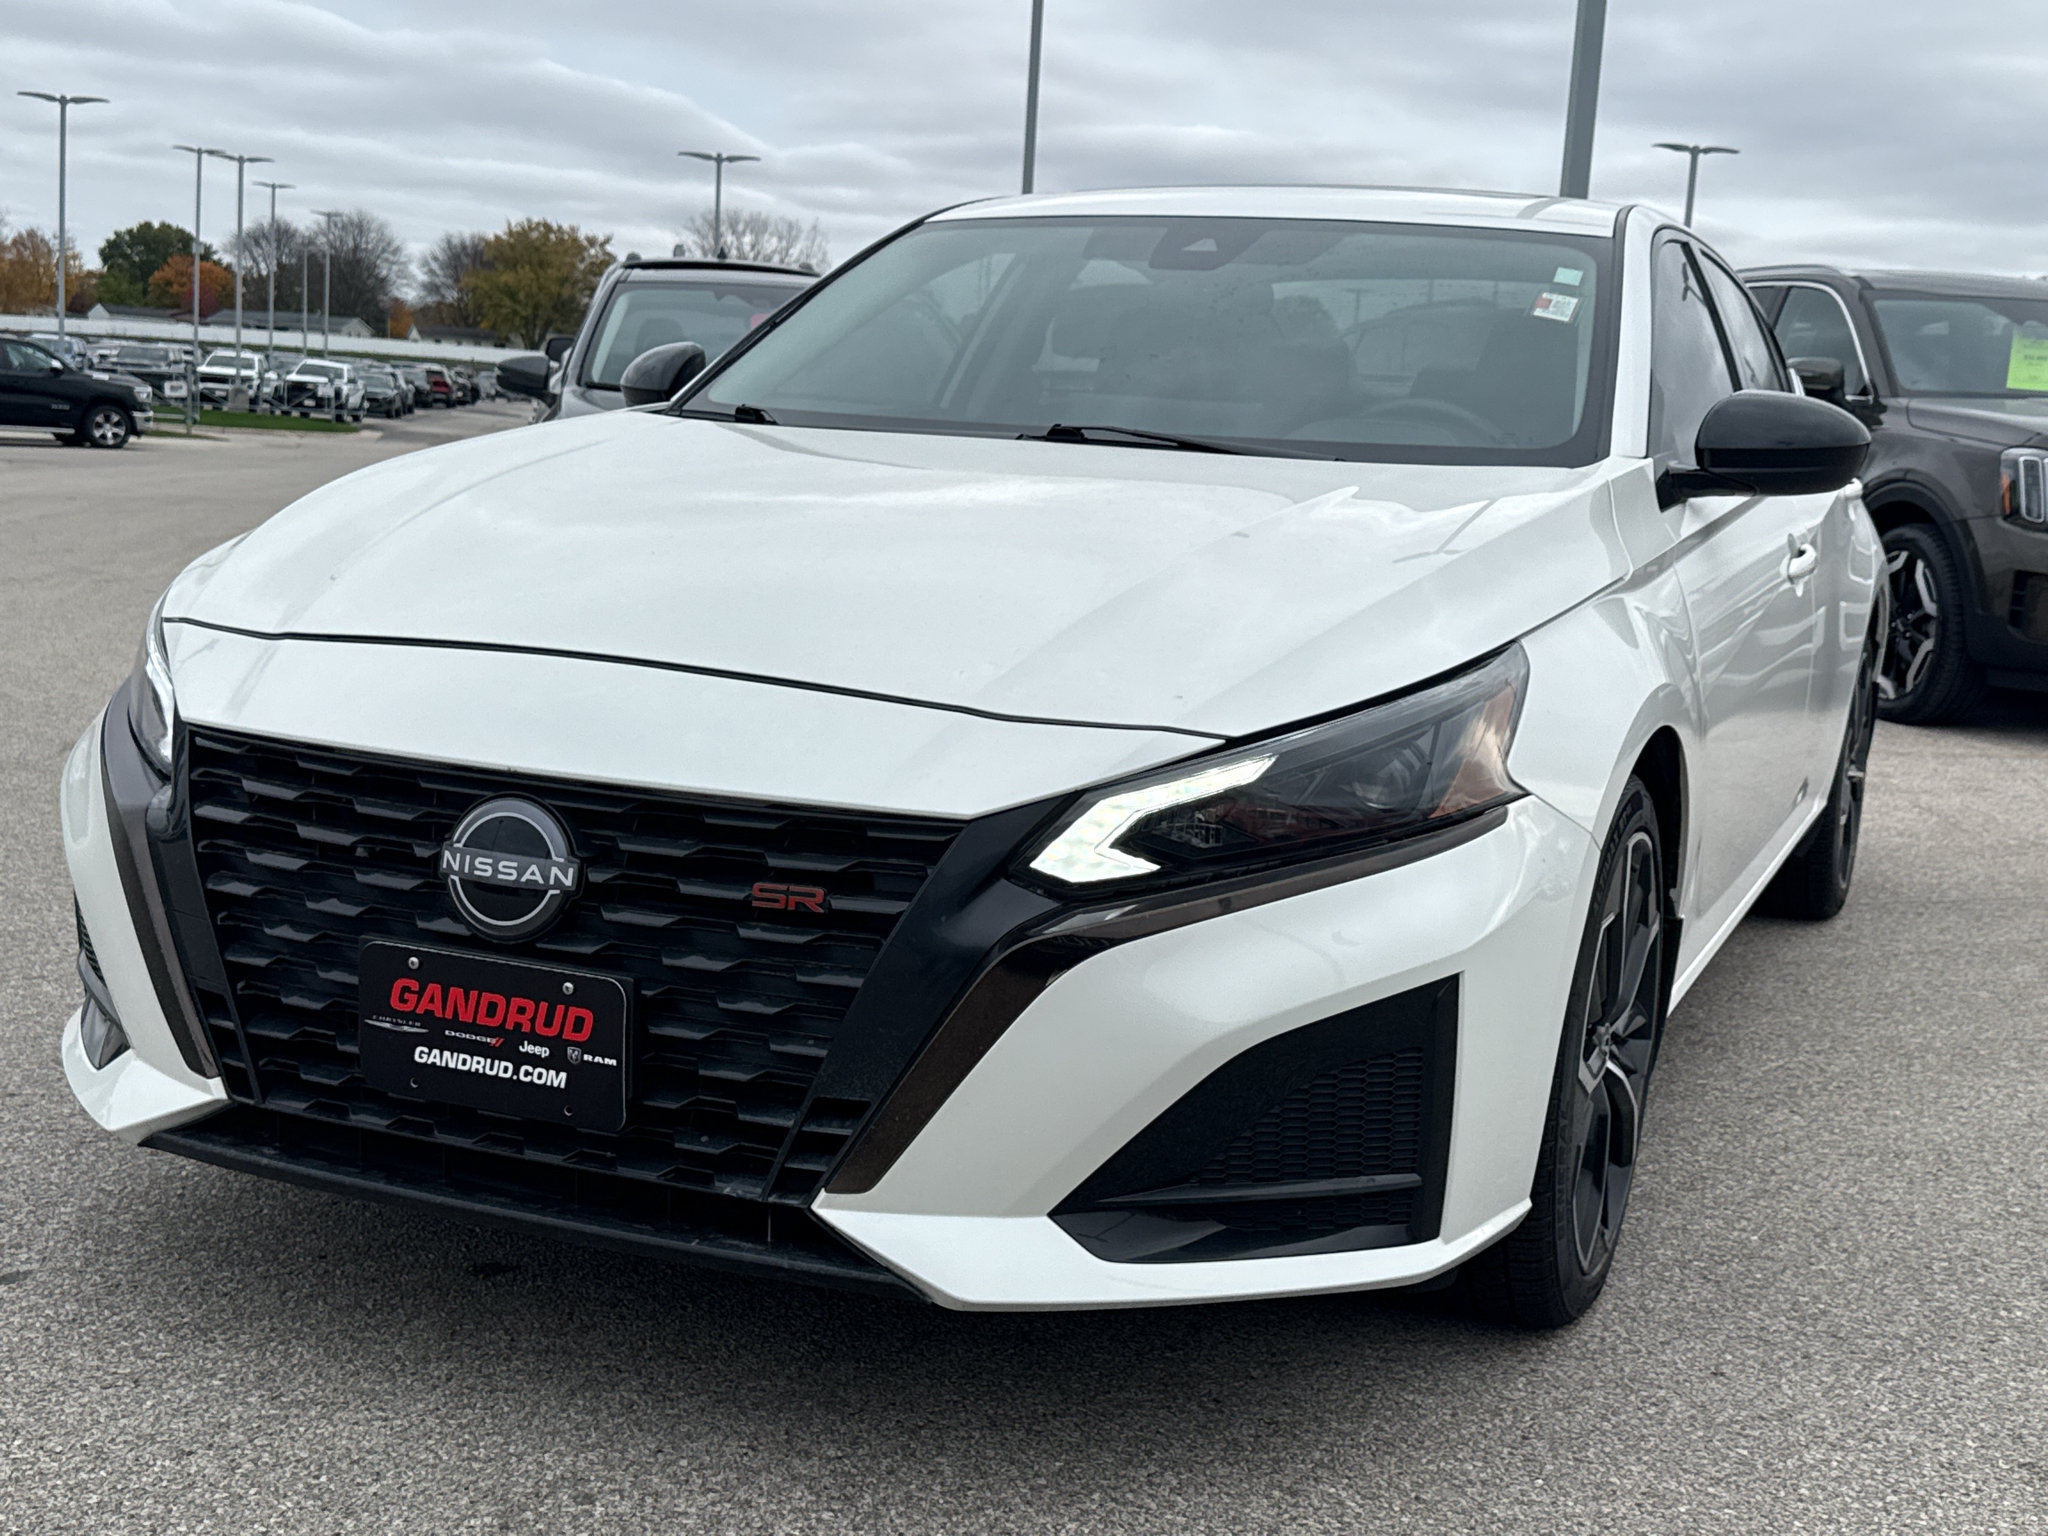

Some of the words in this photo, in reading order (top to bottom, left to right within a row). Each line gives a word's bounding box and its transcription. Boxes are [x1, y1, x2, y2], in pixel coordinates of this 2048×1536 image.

[442, 850, 574, 887] NISSAN
[752, 882, 825, 913] SR
[390, 977, 594, 1042] GANDRUD
[445, 1030, 497, 1044] DODGE
[519, 1040, 550, 1058] Jeep
[583, 1053, 617, 1066] RAM
[414, 1046, 567, 1089] GANDRUD.COM
